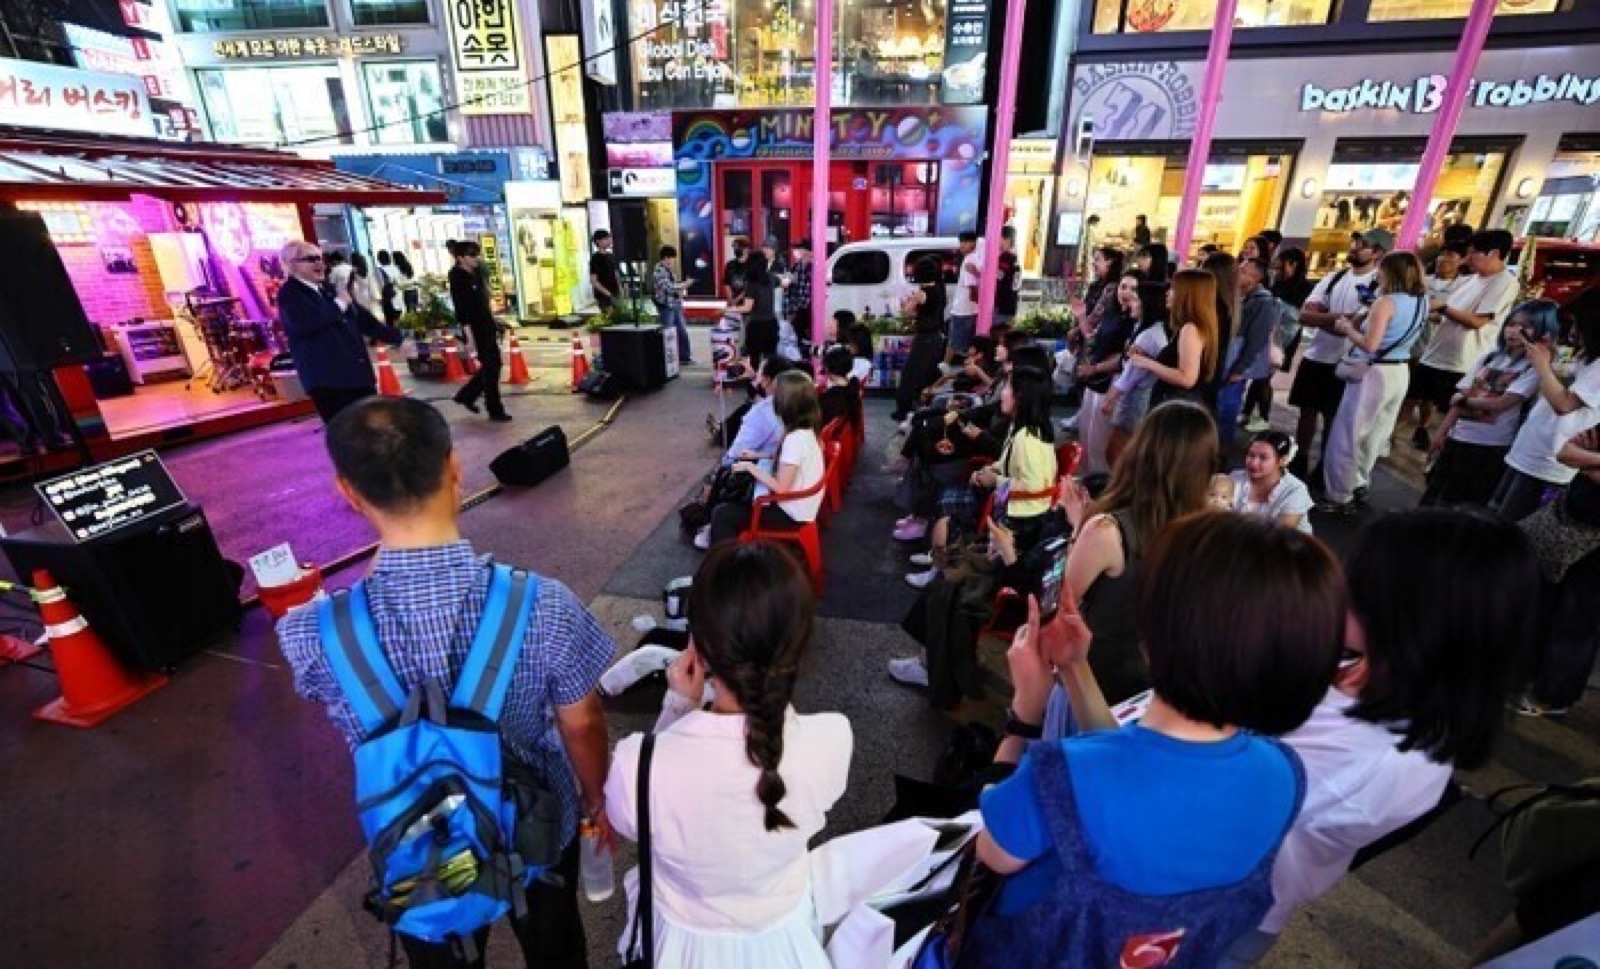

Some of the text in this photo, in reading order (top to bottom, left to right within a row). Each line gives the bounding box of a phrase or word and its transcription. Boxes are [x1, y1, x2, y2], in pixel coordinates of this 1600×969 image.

[462, 33, 509, 64] 속옷
[62, 83, 141, 120] 버스킹
[1301, 80, 1411, 112] baskin
